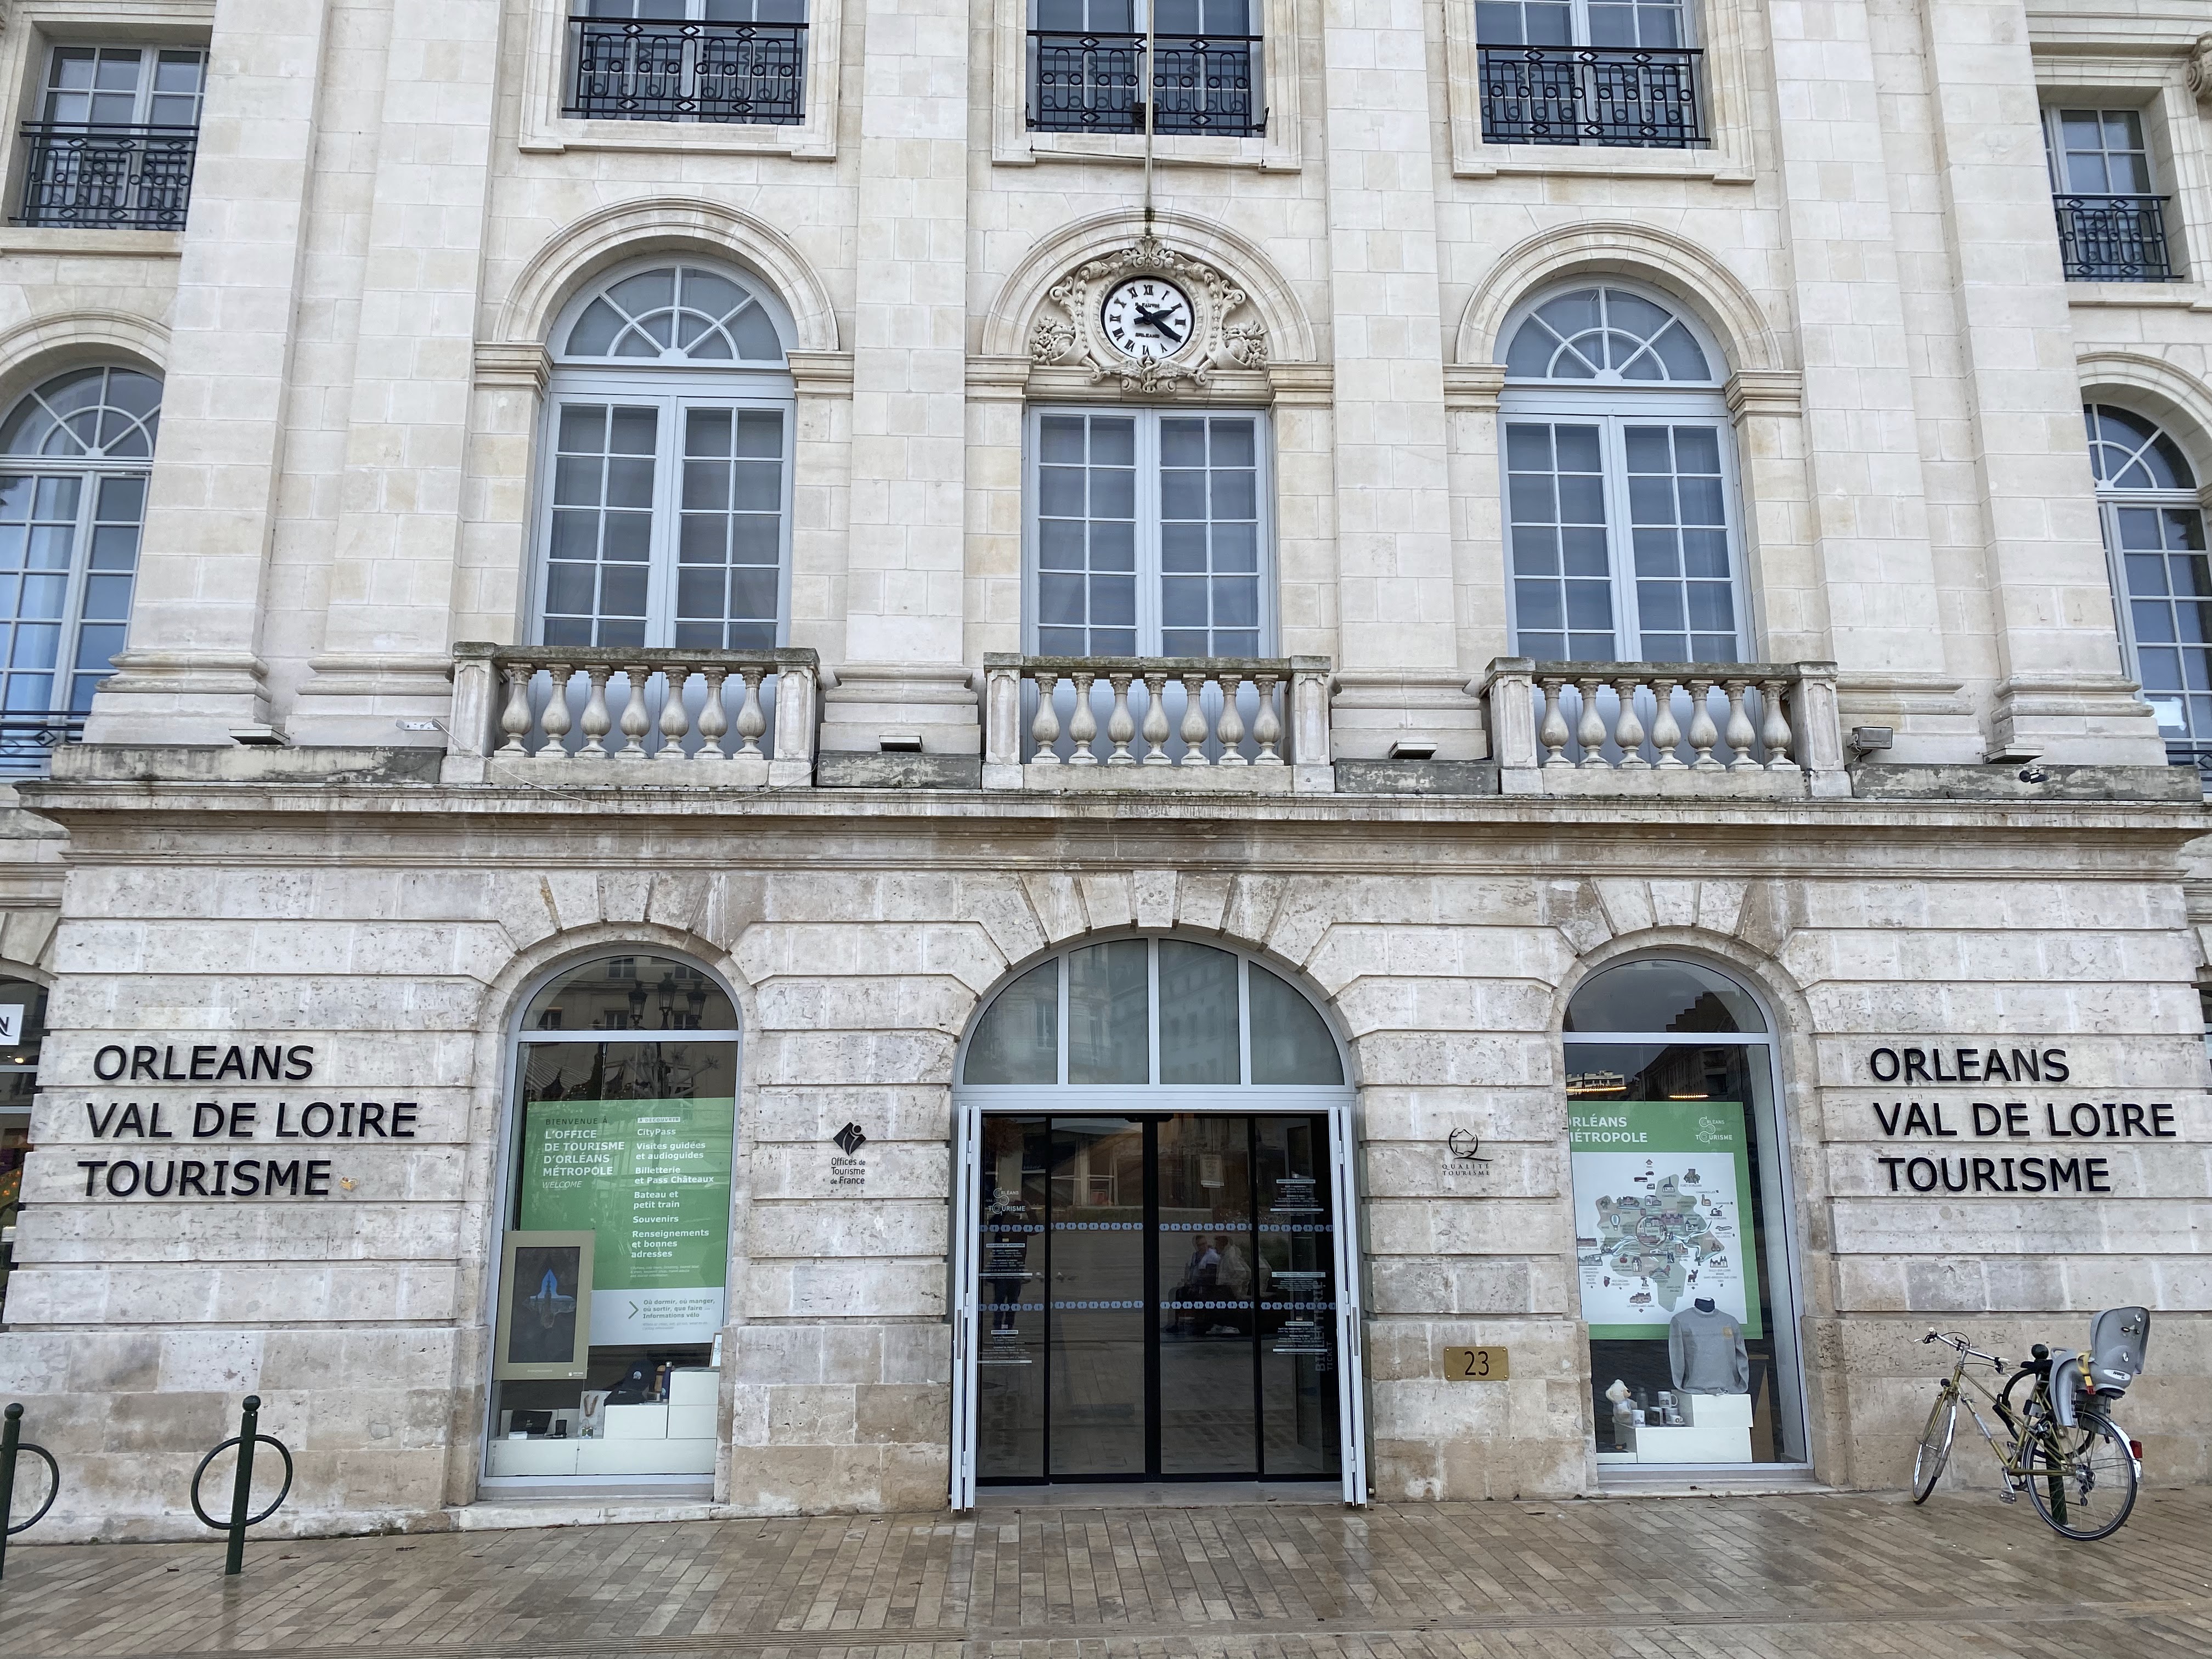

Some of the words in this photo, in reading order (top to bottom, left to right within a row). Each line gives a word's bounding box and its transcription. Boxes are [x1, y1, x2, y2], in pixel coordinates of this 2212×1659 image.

[1143, 285, 1153, 295] XII
[93, 1045, 314, 1081] ORLEANS
[1870, 1047, 2070, 1082] ORLEANS
[86, 1102, 172, 1138] VAL
[192, 1102, 256, 1138] DE
[275, 1102, 417, 1138] LOIRE
[1569, 1113, 1627, 1127] RLÉANS
[1873, 1102, 1957, 1136] VAL
[1972, 1103, 2030, 1136] DE
[2047, 1103, 2177, 1137] LOIRE
[545, 1130, 597, 1139] L'OFFICE
[637, 1128, 676, 1137] CityPass
[1570, 1128, 1647, 1143] ÉTROPOLE
[544, 1143, 560, 1152] DE
[563, 1142, 625, 1151] TOURISME
[670, 1141, 706, 1150] guidées
[544, 1152, 610, 1164] D'ORLÉANS
[647, 1152, 704, 1160] audioguides
[831, 1157, 856, 1165] Offices
[543, 1164, 613, 1176] MÉTROPOLE
[831, 1166, 865, 1175] Tourisme
[1878, 1158, 2111, 1192] TOURISME
[77, 1160, 331, 1197] TOURISME
[634, 1201, 656, 1210] petit
[633, 1215, 679, 1223] Souvenirs
[632, 1229, 709, 1238] Renseignements
[1464, 1351, 1489, 1376] 23
